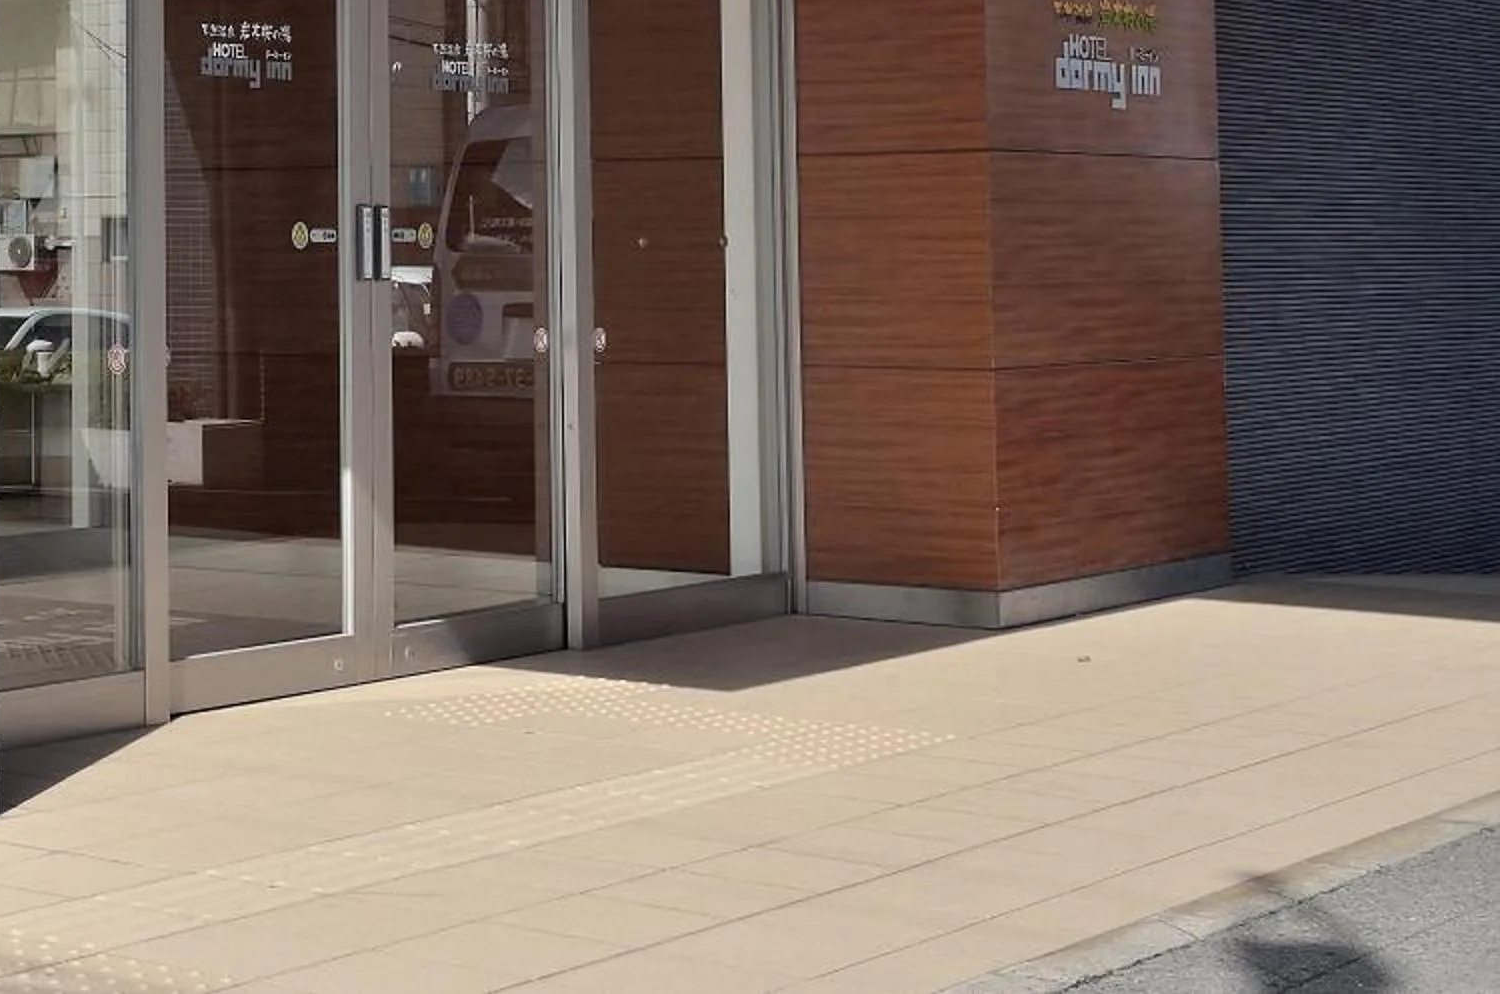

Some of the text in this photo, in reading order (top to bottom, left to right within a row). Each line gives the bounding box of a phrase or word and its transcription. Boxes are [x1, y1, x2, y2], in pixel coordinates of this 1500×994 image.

[213, 42, 248, 59] HOTEL
[1069, 34, 1112, 60] HOTEL
[201, 48, 260, 88] dormy
[266, 60, 293, 81] inn
[1056, 42, 1161, 110] dormy inn
